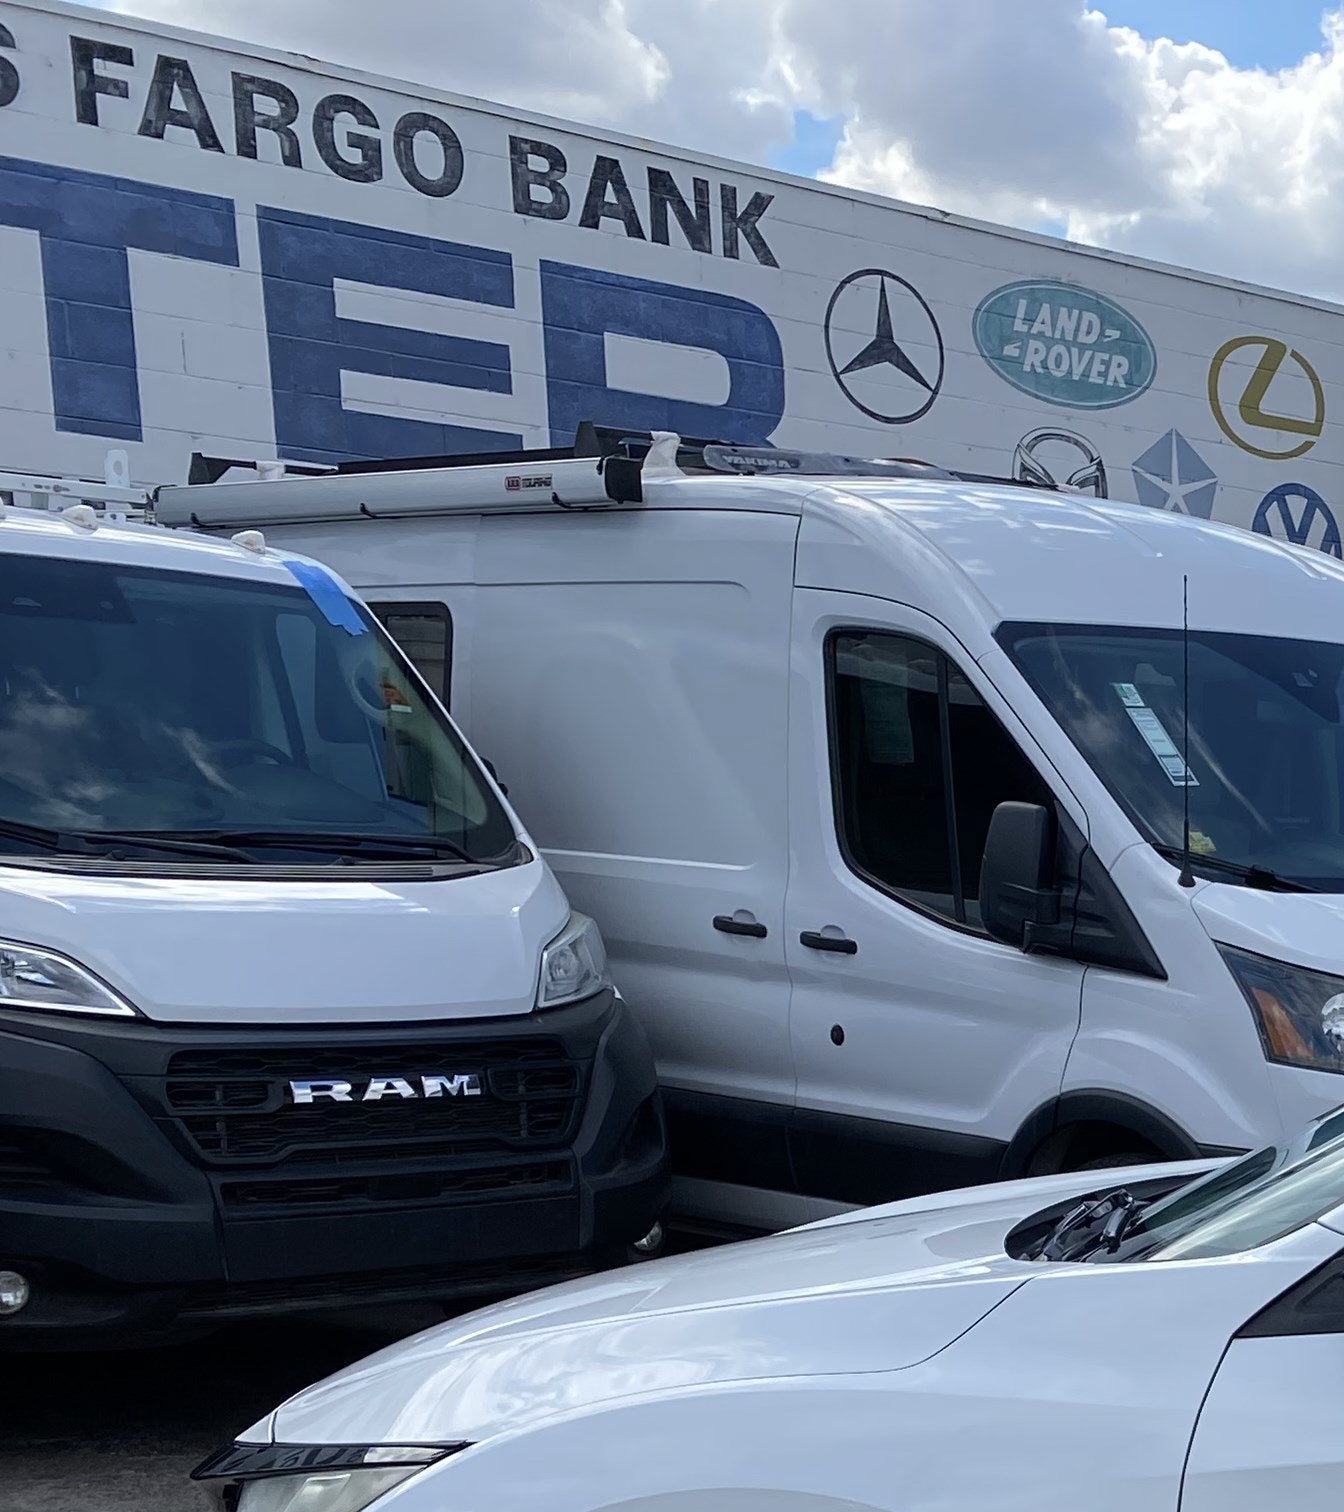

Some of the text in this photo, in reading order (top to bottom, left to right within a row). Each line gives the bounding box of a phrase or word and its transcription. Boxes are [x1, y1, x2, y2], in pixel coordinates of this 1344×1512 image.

[69, 35, 465, 198] FARGO
[508, 134, 780, 269] BANK
[0, 154, 786, 450] TER
[1013, 299, 1101, 344] LAND
[1022, 338, 1129, 388] ROVER
[289, 1074, 481, 1104] RAM
